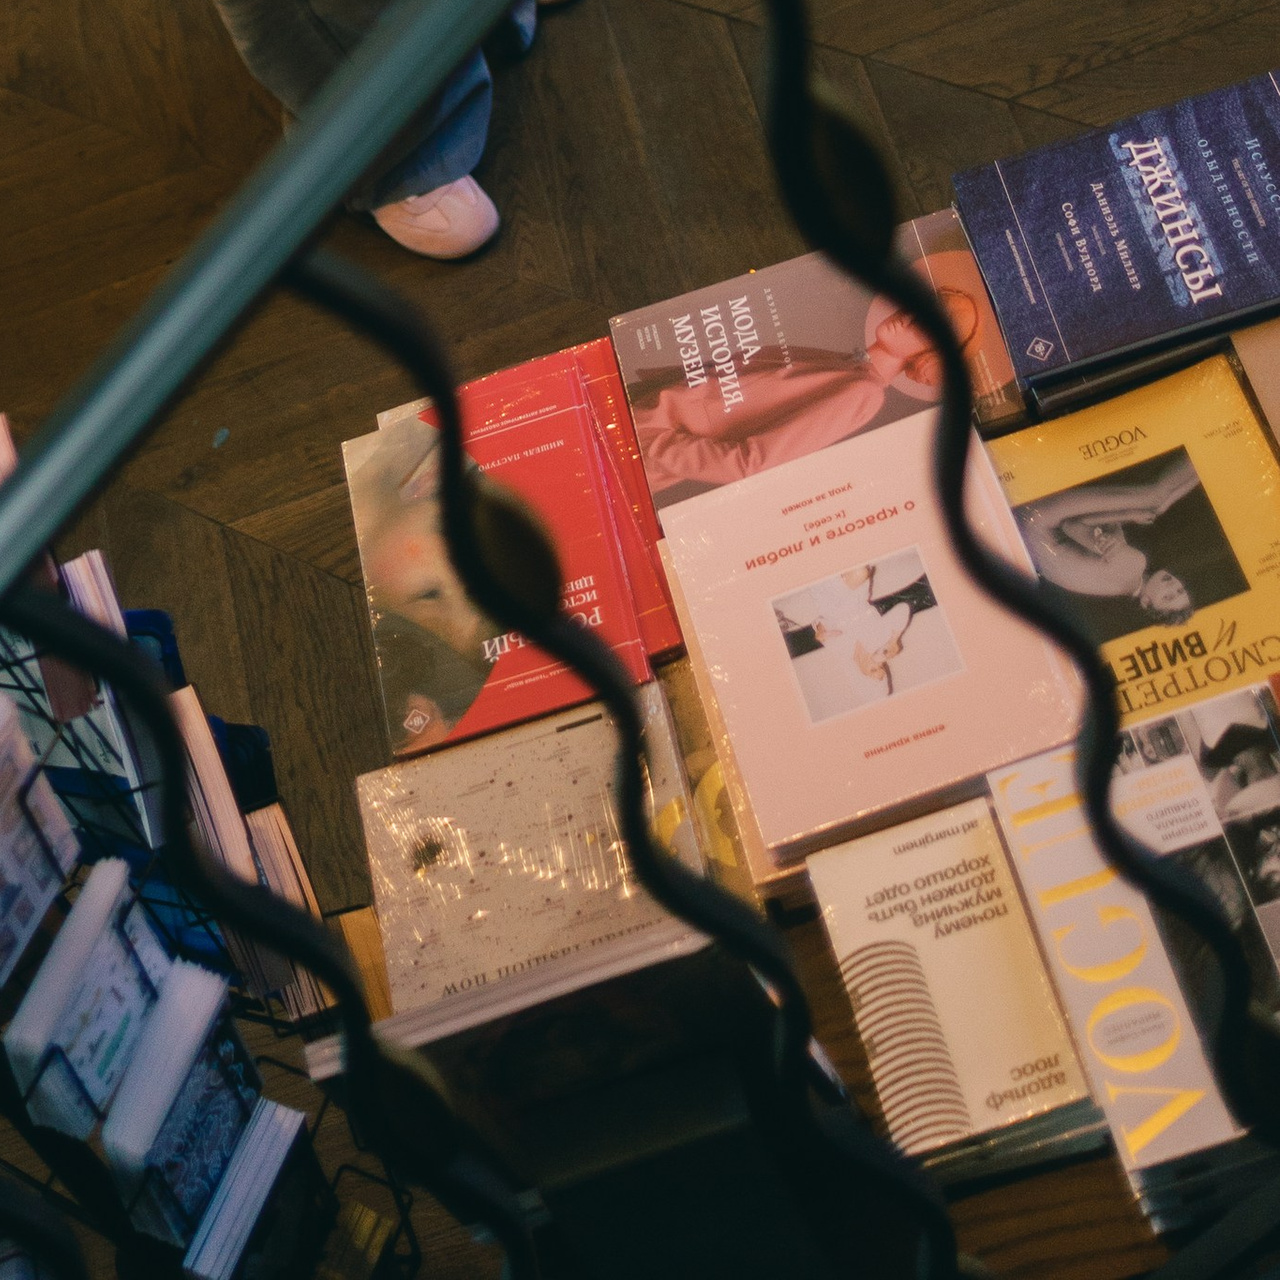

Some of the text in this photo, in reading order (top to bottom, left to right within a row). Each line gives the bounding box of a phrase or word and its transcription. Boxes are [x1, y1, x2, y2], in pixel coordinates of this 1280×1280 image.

[1120, 132, 1222, 305] ДЖИНСЫ
[1196, 138, 1258, 264] ОБЫДЕННОСТИ
[762, 287, 780, 328] ДЖУЛИЯ
[670, 313, 707, 388] МУЗЕИ
[727, 294, 764, 366] МОДА,
[1032, 340, 1047, 358] 18+
[698, 304, 746, 414] ИСТОРИЯ,
[476, 438, 564, 472] МИШЕЛЬ ПАСТУРО
[1077, 423, 1146, 461] VOGUE
[780, 481, 852, 515] уход за кожей
[744, 499, 915, 571] о красоте и любви
[802, 513, 832, 532] себе]
[1103, 629, 1206, 687] ВИДЕТ
[1112, 633, 1280, 716] СМОТРЕТ
[406, 713, 425, 728] 18+
[863, 723, 945, 758] елена крыгина
[891, 819, 979, 857] ad marginem
[861, 853, 992, 910] хорошо одет
[866, 868, 998, 926] должен быть
[910, 884, 1003, 929] мужчина
[931, 902, 1009, 940] почему
[994, 746, 1221, 1162] VOGUE
[1008, 1052, 1061, 1082] лоос
[983, 1069, 1067, 1113] адольф
